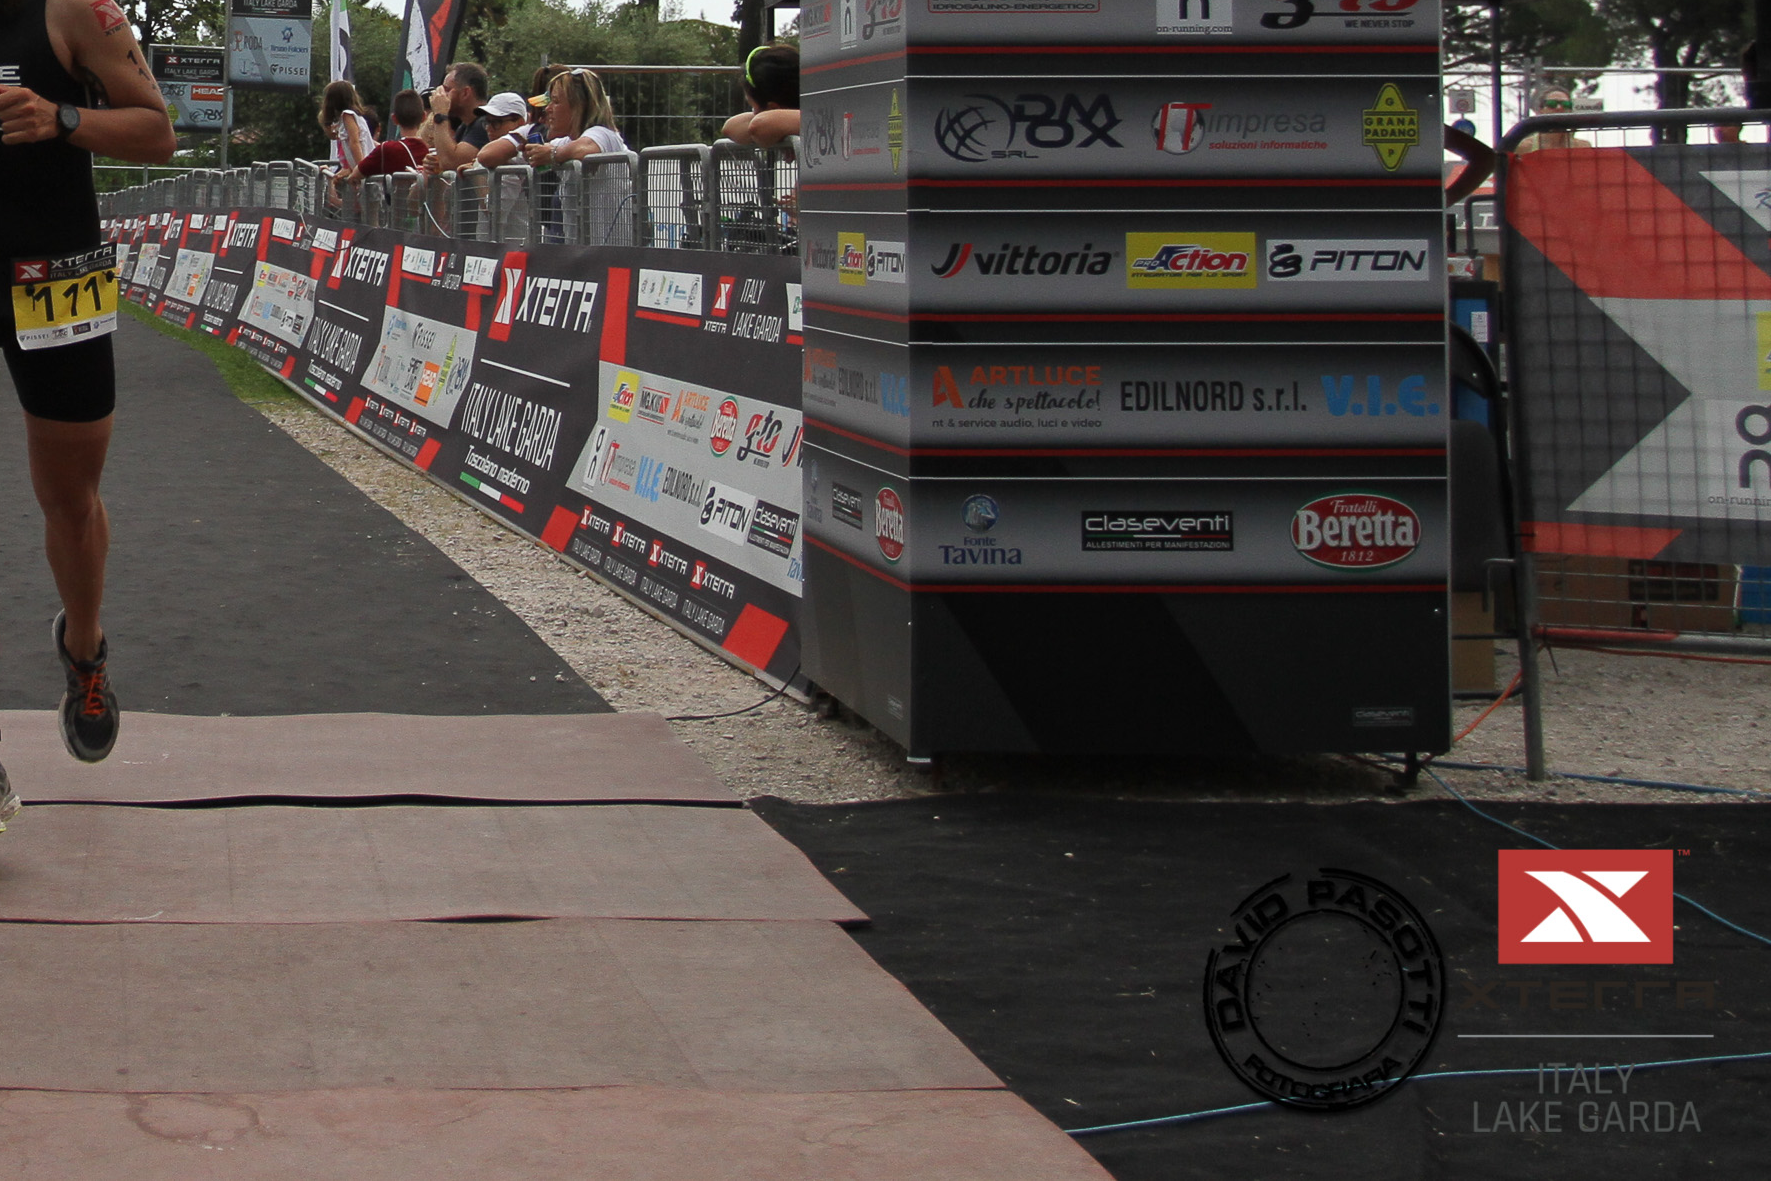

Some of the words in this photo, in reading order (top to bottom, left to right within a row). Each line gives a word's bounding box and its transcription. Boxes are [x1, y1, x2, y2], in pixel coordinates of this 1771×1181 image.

[261, 0, 276, 8] LAKE
[1156, 24, 1233, 34] on-running.com
[1344, 20, 1359, 30] WE
[1362, 20, 1390, 29] NEVER
[1392, 19, 1414, 29] STOP
[1207, 111, 1327, 139] impresa
[1364, 117, 1417, 127] GRANA
[1364, 128, 1418, 138] PADANO
[1209, 140, 1258, 151] soluzioni
[1259, 139, 1328, 151] informatiche
[51, 246, 112, 269] XTERRA
[974, 242, 1113, 277] vittoria
[1310, 249, 1427, 272] PITON
[34, 276, 102, 323] 111
[740, 278, 766, 305] ITALY
[515, 276, 599, 333] XTERRA
[731, 311, 755, 340] LAKE
[753, 314, 783, 344] GARDA
[969, 366, 1102, 386] ARTLUCE
[968, 389, 997, 410] che
[1005, 387, 1101, 415] spettacolo!
[1120, 381, 1244, 413] EDILNORD
[1252, 381, 1308, 413] s.r.l.
[486, 392, 523, 454] LAKE
[514, 400, 563, 471] GARDA
[1330, 499, 1378, 515] Fratelli
[1085, 514, 1229, 532] claseventi
[1296, 509, 1416, 549] Beretta
[963, 536, 997, 546] Fonte
[1085, 540, 1143, 549] ALLESTIMENTI
[1146, 540, 1162, 549] PER
[1164, 540, 1230, 549] MANIFESTAZIONI
[938, 545, 1023, 566] Tavina
[1340, 550, 1374, 563] 1812
